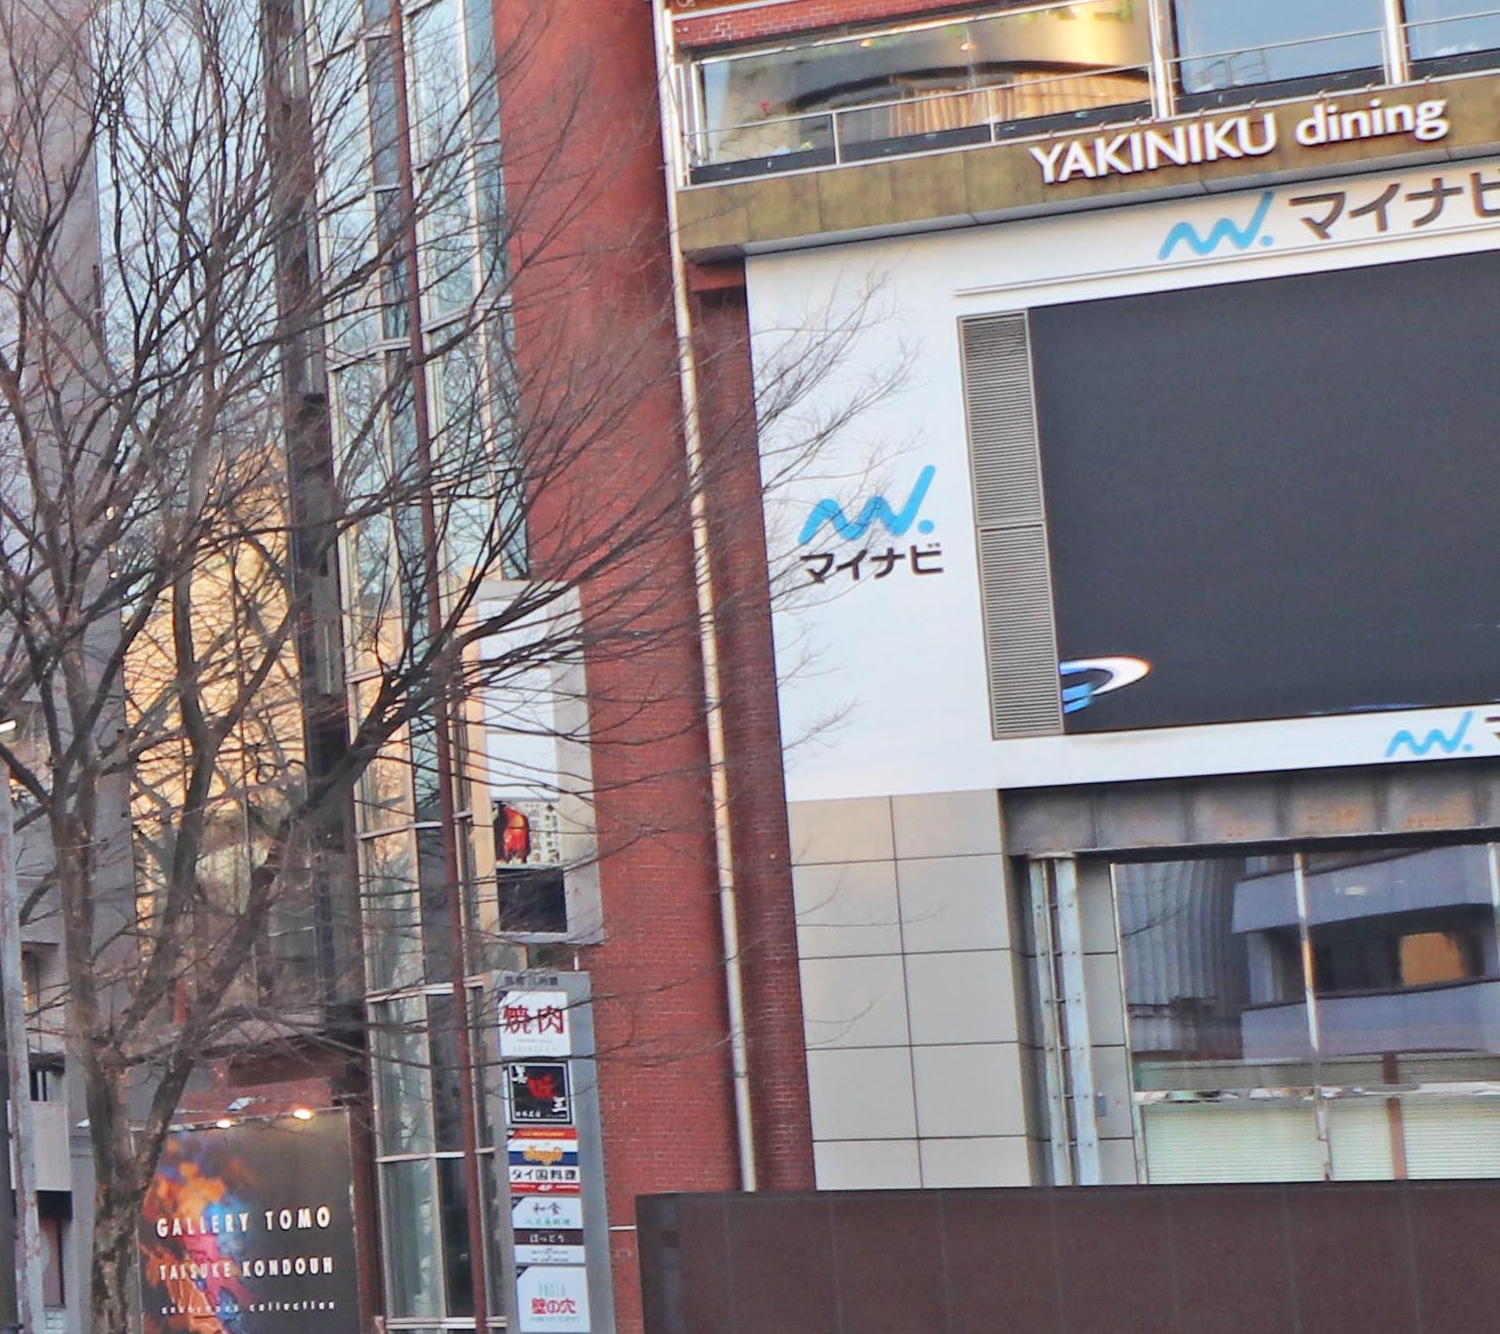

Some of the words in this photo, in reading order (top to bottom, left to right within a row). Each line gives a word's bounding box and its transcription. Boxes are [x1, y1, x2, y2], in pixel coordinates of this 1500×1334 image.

[1029, 112, 1279, 185] YAKINIKU
[1295, 98, 1450, 147] dining
[799, 543, 944, 584] マイナビ
[156, 1212, 250, 1239] GALLERY
[264, 1204, 332, 1231] TOMO
[242, 1255, 334, 1278] KONDOUH
[531, 1297, 577, 1315] 壁の穴
